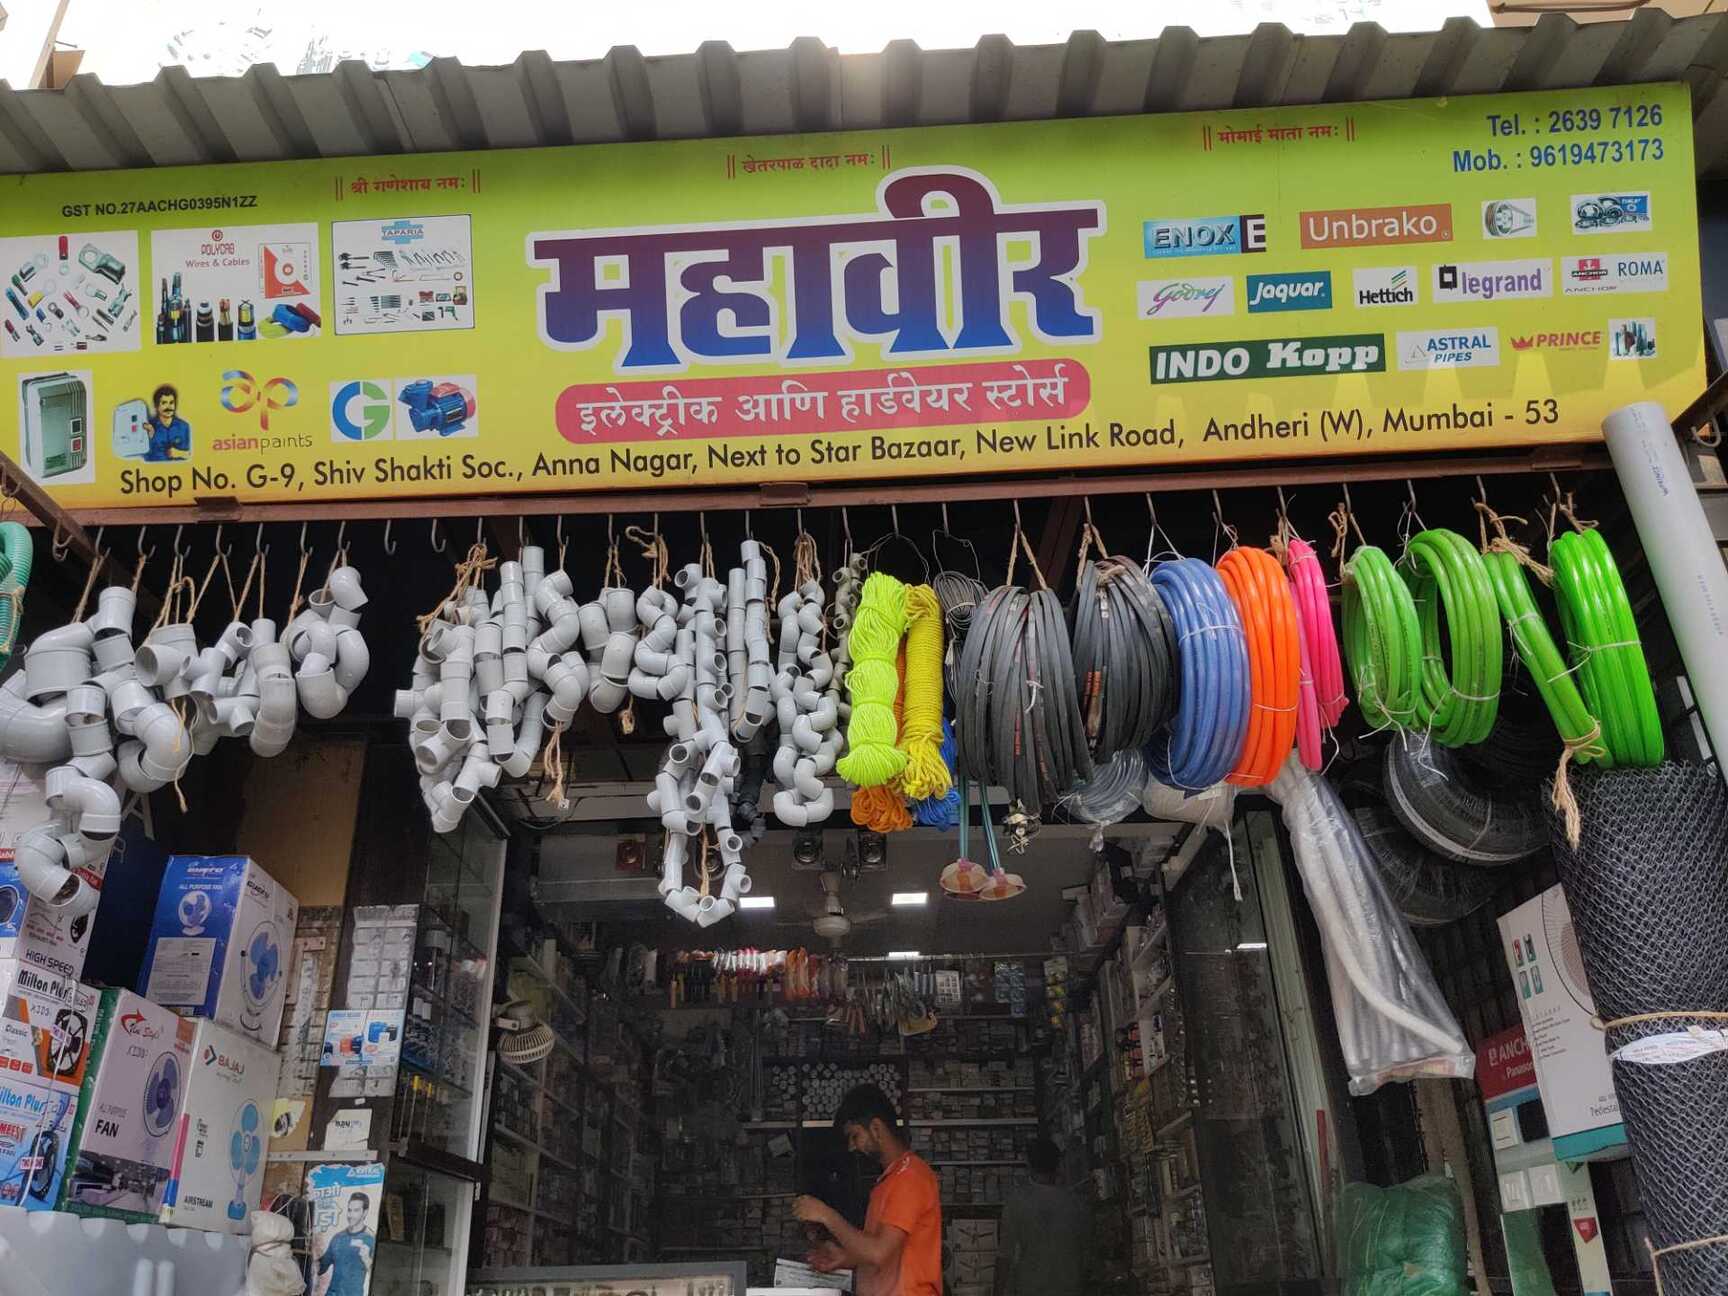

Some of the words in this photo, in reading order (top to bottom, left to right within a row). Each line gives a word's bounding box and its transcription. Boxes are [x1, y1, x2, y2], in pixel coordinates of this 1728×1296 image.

[1487, 114, 1526, 137] Tel.
[1549, 108, 1601, 133] 2639
[1609, 104, 1663, 129] 7126
[1267, 127, 1304, 141] माता
[809, 155, 841, 170] दादा
[1453, 149, 1508, 172] Mob.
[1530, 138, 1664, 168] 9619473173
[62, 203, 91, 218] GST
[381, 228, 424, 238] TAPARIA
[1308, 210, 1437, 241] Unbrako
[1153, 223, 1236, 249] ENOX
[186, 258, 210, 268] Wires
[223, 257, 250, 267] Cables
[530, 169, 1103, 371] महावीर
[1617, 260, 1664, 277] ROMA
[1461, 268, 1542, 299] legrand
[1359, 287, 1414, 304] Hettich
[1427, 334, 1492, 351] ASTRAL
[1536, 331, 1600, 347] PRINCE
[1155, 347, 1251, 380] INDO
[1266, 341, 1379, 372] Kopp
[1434, 351, 1472, 363] PIPES
[575, 385, 722, 437] इलेक्ट्रीक
[735, 379, 829, 422] आणि
[838, 371, 974, 424] हार्डवेयर
[982, 363, 1070, 408] स्टोर्स
[120, 468, 182, 498] Shop
[192, 466, 235, 490] No.
[246, 463, 304, 491] G-9,
[314, 460, 365, 486] Shiv
[375, 455, 452, 483] Shakti
[462, 454, 524, 481] Soc.,
[531, 452, 600, 476] Anna
[610, 448, 698, 477] Nagar,
[708, 444, 767, 468] Next
[776, 443, 801, 465] to
[810, 439, 862, 464] Star
[871, 435, 966, 461] Bazaar,
[977, 429, 1037, 454] New
[1047, 423, 1101, 450] Link
[1110, 418, 1185, 447] Road,
[1203, 412, 1310, 442] Andheri
[1320, 408, 1372, 441] (W),
[1383, 402, 1494, 433] Mumbai
[1525, 399, 1560, 425] 53
[18, 969, 48, 992] Milton
[95, 1118, 119, 1138] FAN
